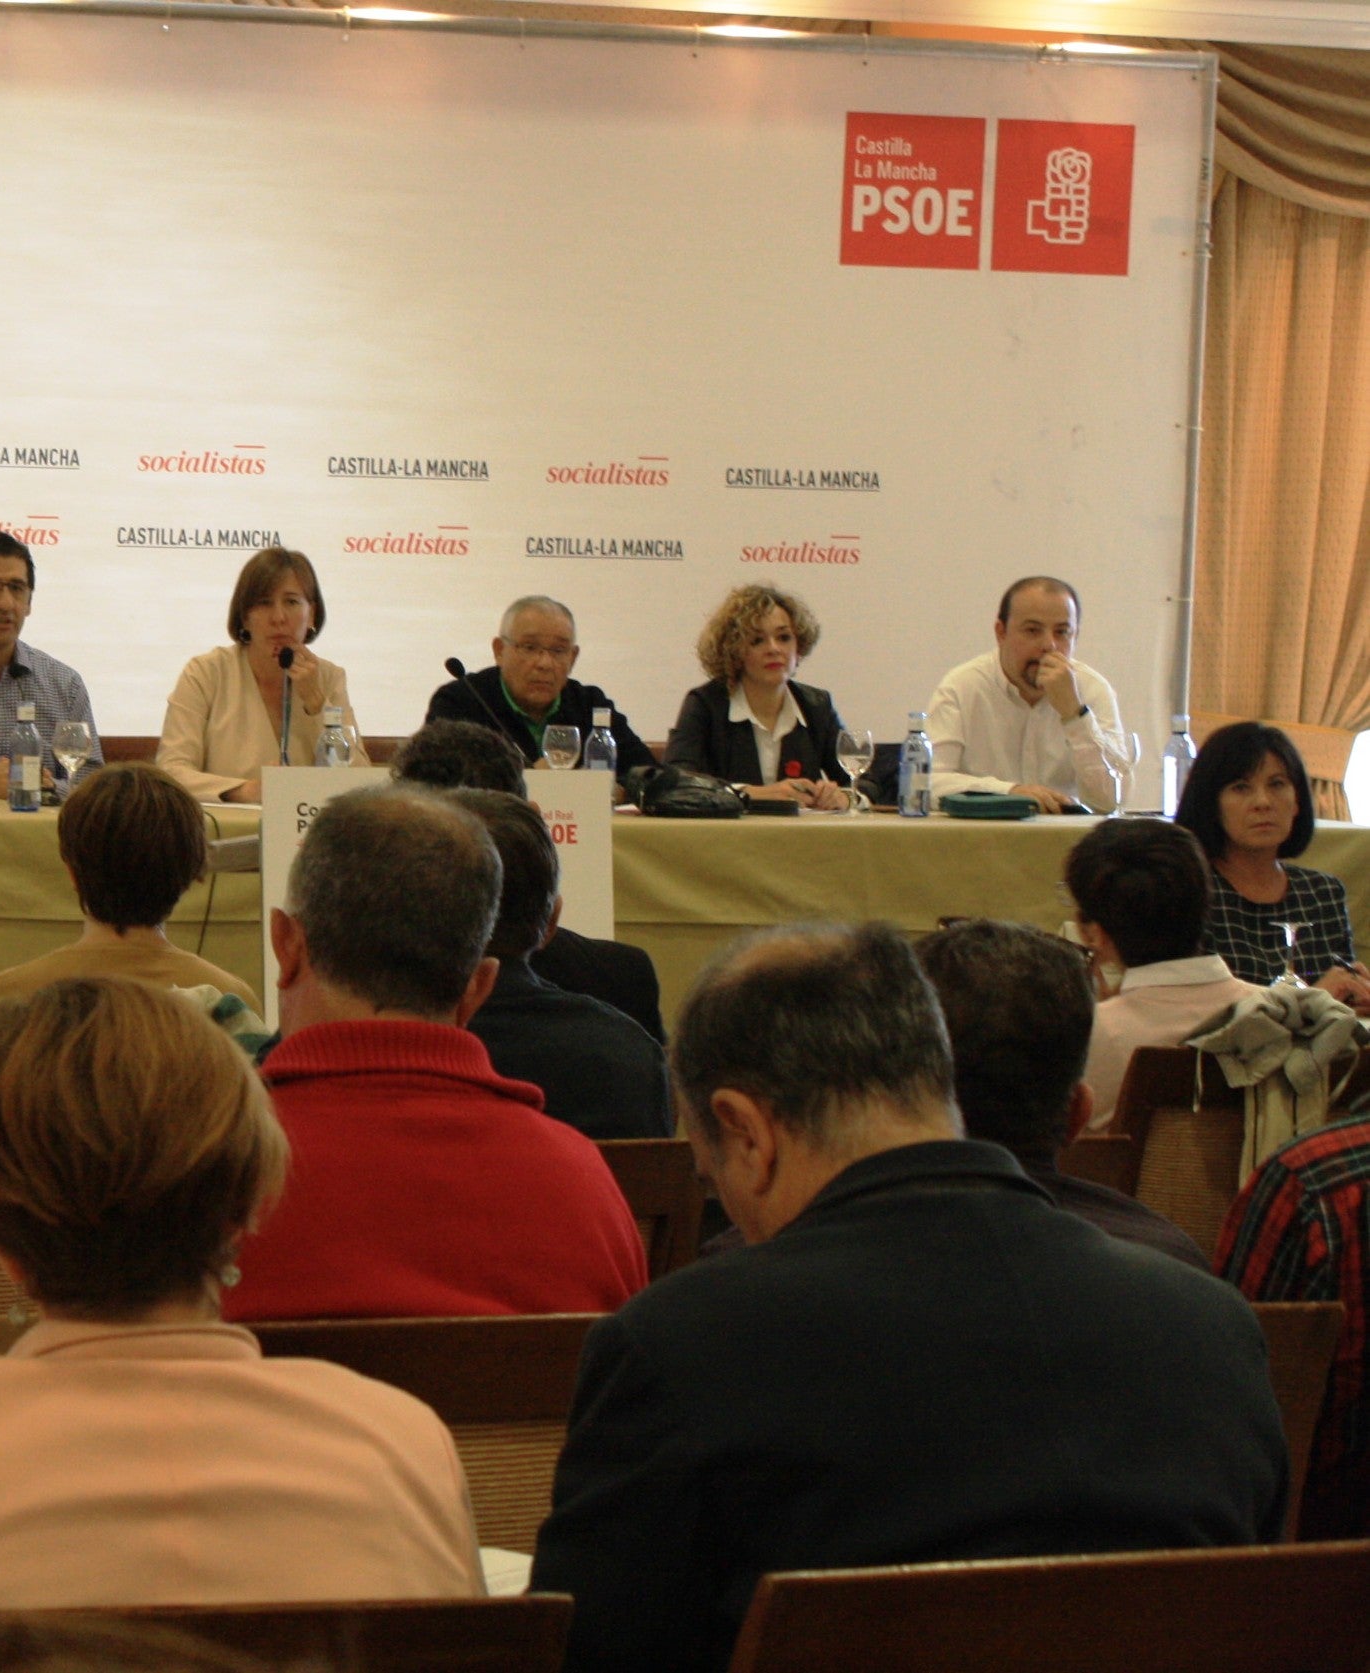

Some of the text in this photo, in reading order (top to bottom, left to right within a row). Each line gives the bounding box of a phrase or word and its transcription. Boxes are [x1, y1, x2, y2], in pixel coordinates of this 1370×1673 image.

[855, 135, 912, 156] Castilla
[855, 160, 938, 181] La Mancha
[851, 184, 974, 236] PSOE
[15, 447, 80, 467] MANCHA
[138, 450, 266, 475] socialistas
[328, 456, 489, 479] CASTILLA-LA MANCHA
[546, 461, 669, 487] socialistas
[725, 467, 880, 490] CASTILLA-LA MANCHA
[116, 527, 281, 548] CASTILLA-LA MANCHA
[343, 531, 470, 556] socialistas
[525, 537, 684, 558] CASTILLA-LA MANCHA
[739, 541, 861, 565] socialistas
